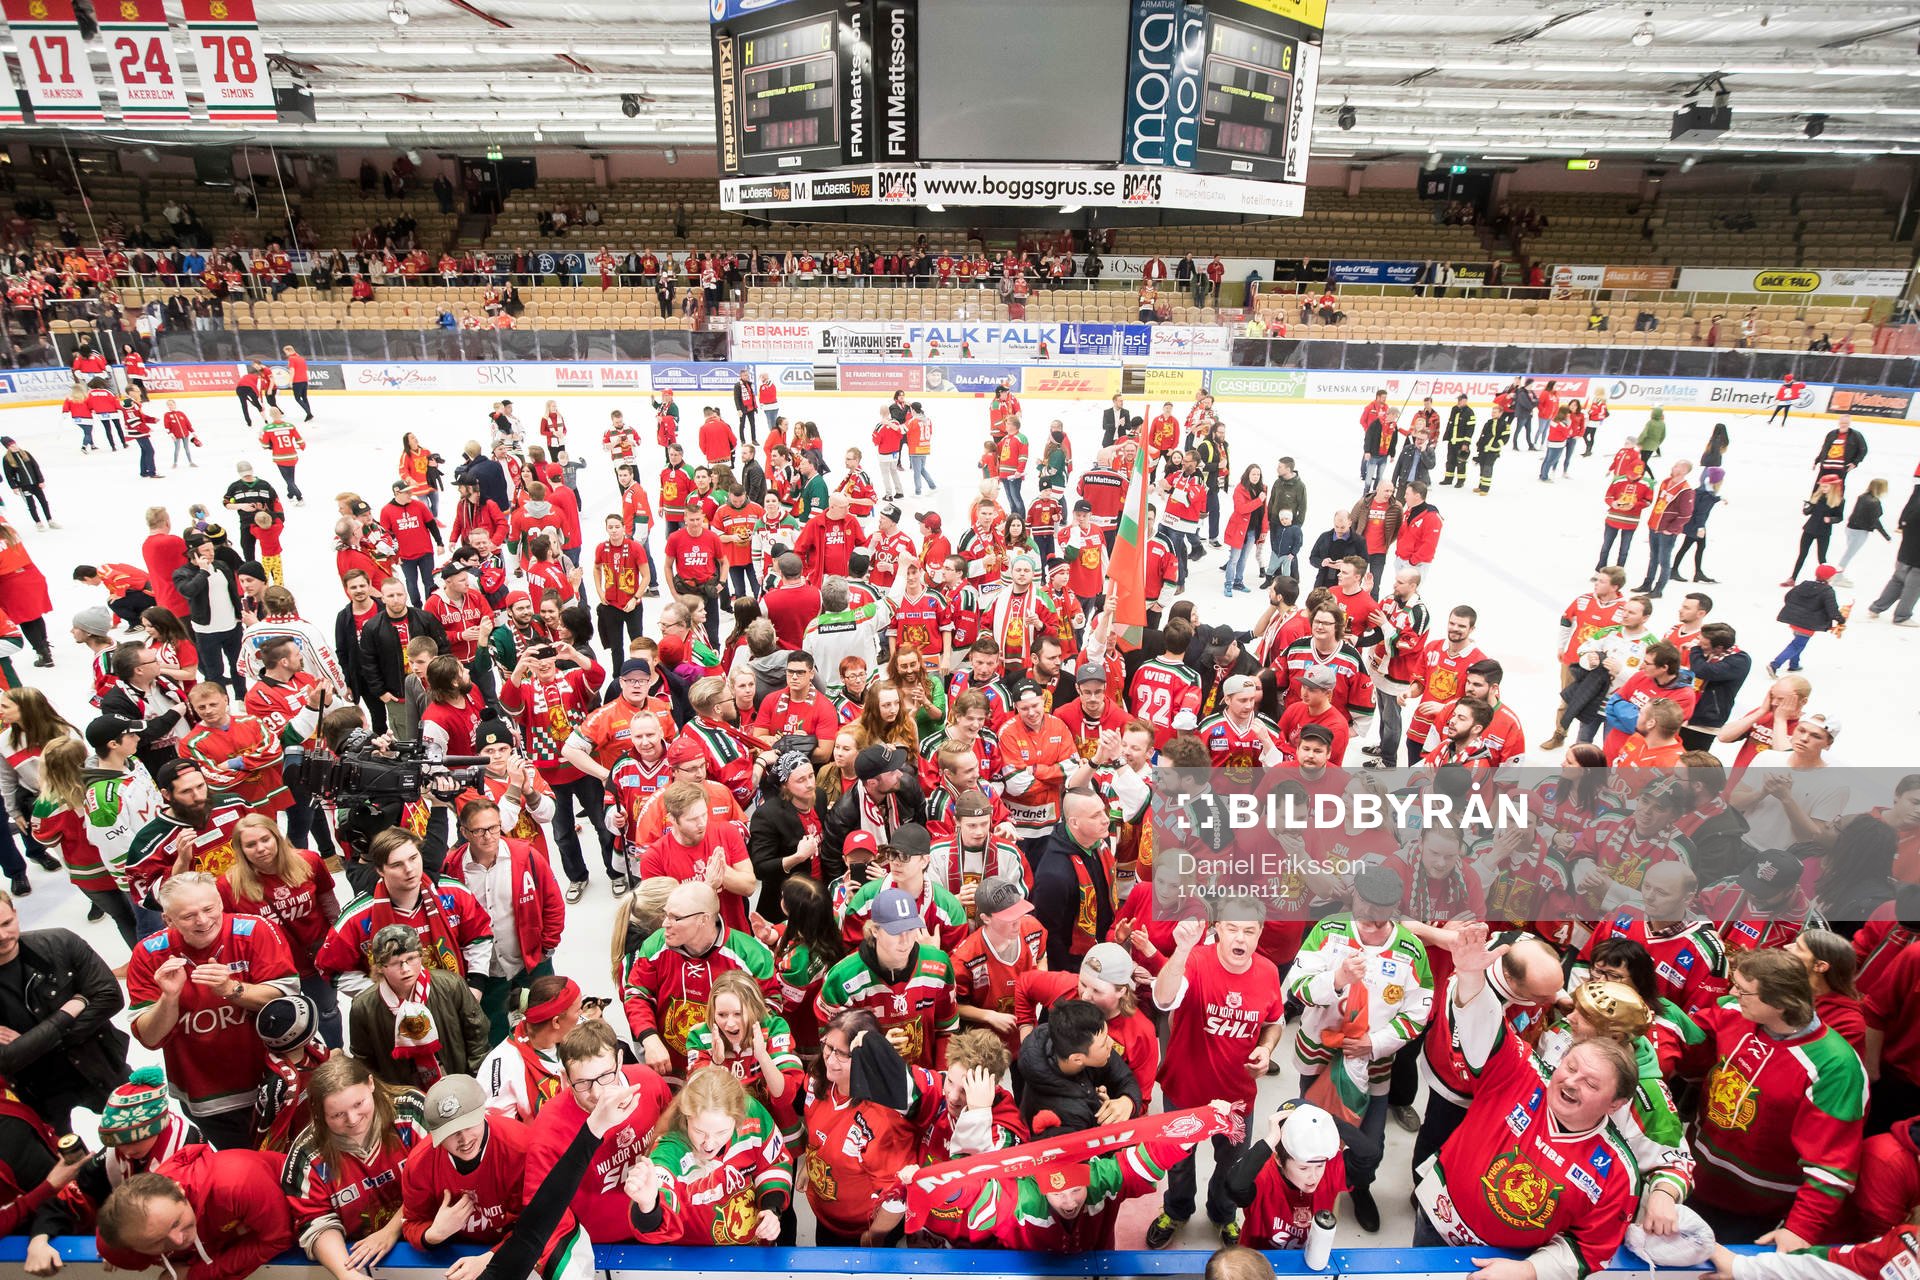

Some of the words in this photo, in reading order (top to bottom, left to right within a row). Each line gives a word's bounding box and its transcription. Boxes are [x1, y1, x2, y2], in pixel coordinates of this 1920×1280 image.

[29, 36, 74, 84] 17
[114, 37, 173, 84] 24
[200, 36, 258, 84] 78
[745, 42, 753, 65] H
[887, 9, 906, 117] Mattsson
[1282, 46, 1291, 71] G
[850, 13, 862, 121] Mattsson
[42, 89, 83, 99] HANSSON
[221, 88, 254, 99] SIMONS
[1132, 13, 1174, 165] mora
[1172, 19, 1202, 167] mora
[851, 122, 862, 157] FM
[888, 119, 906, 155] FM
[741, 187, 772, 199] MJÖBERG
[773, 186, 790, 200] bygg
[813, 182, 850, 195] MJÖBERG
[851, 181, 871, 197] bygg
[878, 172, 917, 198] BOGGS
[924, 175, 1116, 201] www.boggsgrus.se
[1123, 174, 1162, 200] BOGGS
[757, 325, 810, 337] BRAHUS
[909, 327, 980, 343] FALK
[986, 328, 1057, 344] FALK
[477, 366, 516, 384] SRR
[1217, 379, 1296, 394] CASHBUDDY
[1317, 384, 1358, 393] SVENSKA
[1433, 381, 1498, 396] BRAHUS
[1630, 384, 1698, 397] DynaMate
[1711, 387, 1775, 405] Bilmetr
[277, 435, 292, 449] 19
[1143, 669, 1172, 684] WIBE
[1137, 684, 1171, 727] 22
[262, 711, 285, 730] 39
[896, 898, 911, 917] U
[1734, 920, 1760, 939] WIBE
[1206, 1003, 1218, 1014] NU
[1235, 1008, 1243, 1019] VI
[1243, 1009, 1260, 1021] MOT
[1203, 1016, 1258, 1039] SHL!
[597, 1160, 611, 1175] NU
[610, 1149, 631, 1168] KÖR
[631, 1143, 643, 1155] VI
[1535, 1135, 1565, 1168] WIBE
[1004, 1162, 1027, 1173] EST.
[1487, 1157, 1508, 1180] MORA
[1536, 1198, 1555, 1223] KLUBB
